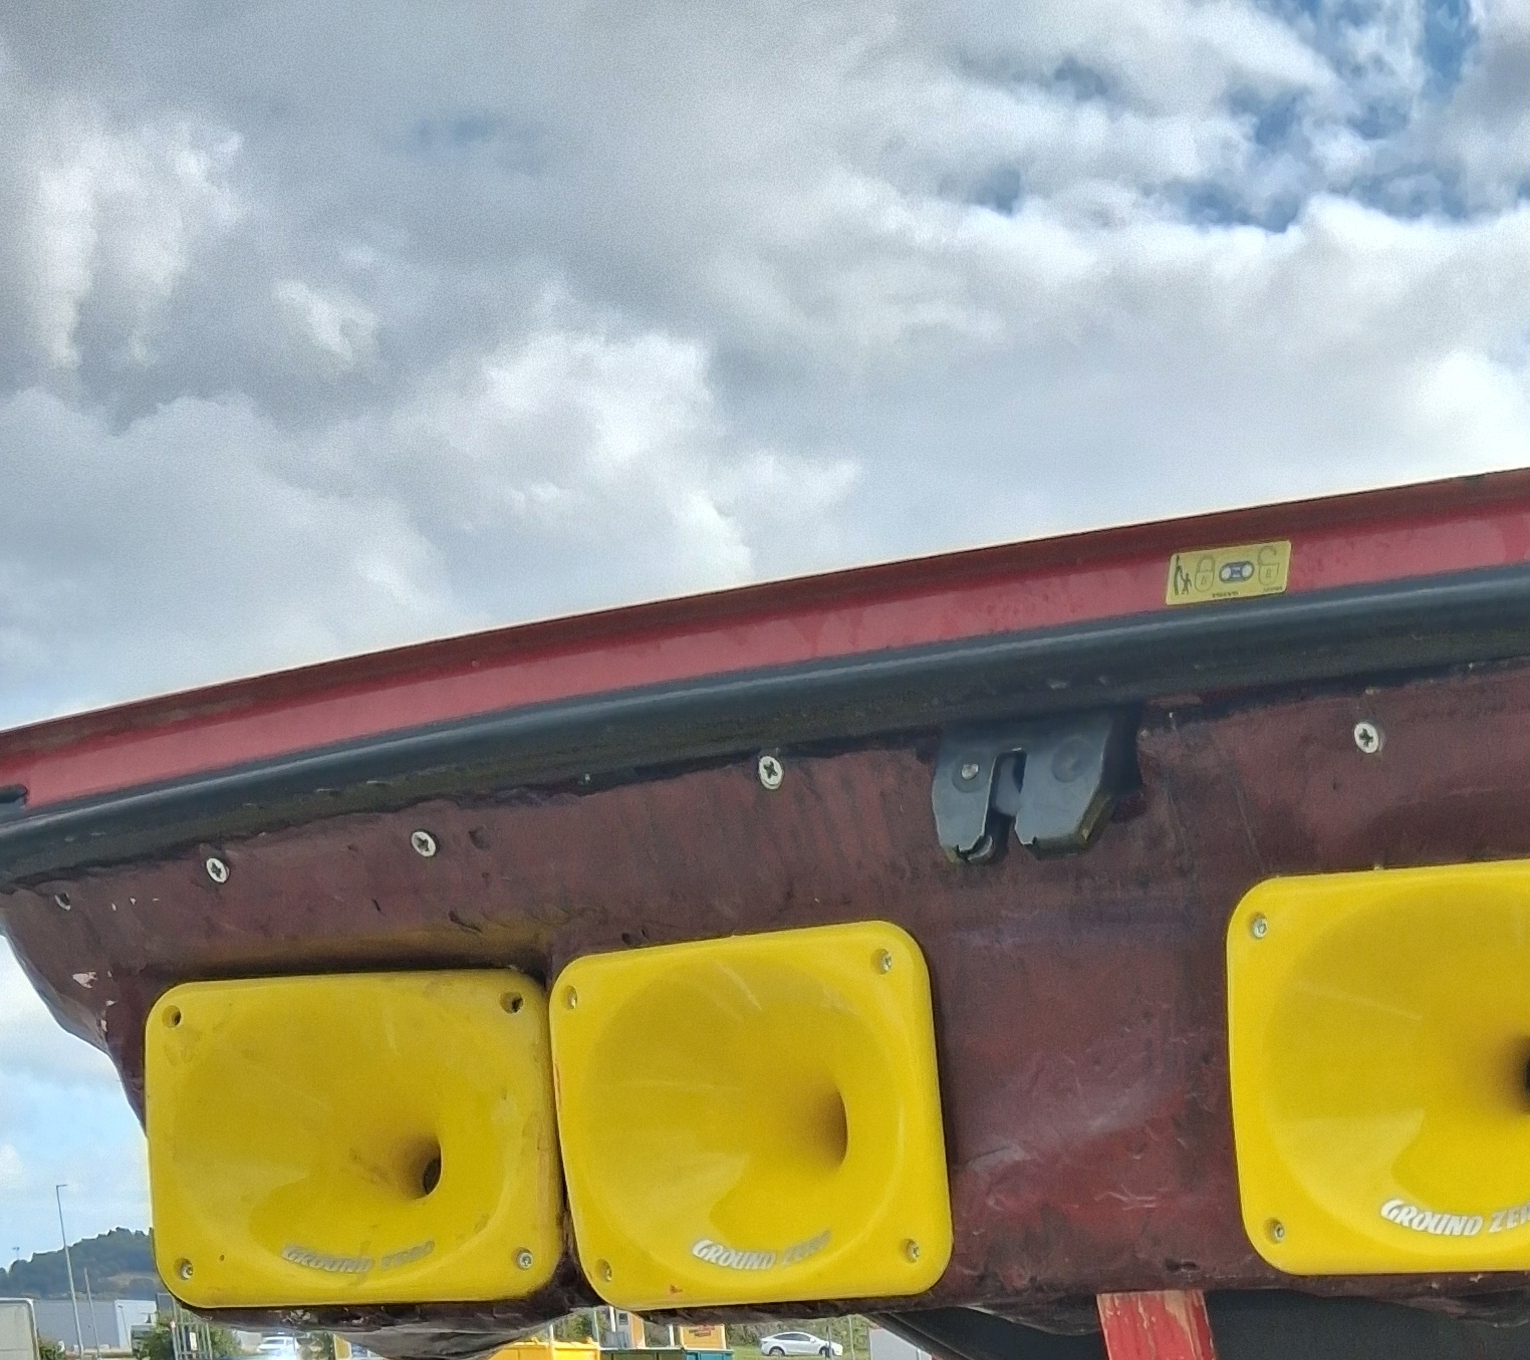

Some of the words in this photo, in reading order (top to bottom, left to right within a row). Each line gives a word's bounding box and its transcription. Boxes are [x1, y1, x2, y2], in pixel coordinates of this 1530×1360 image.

[1380, 1198, 1483, 1237] GROUND
[282, 1244, 375, 1274] GROUND
[692, 1239, 777, 1270] GROUND
